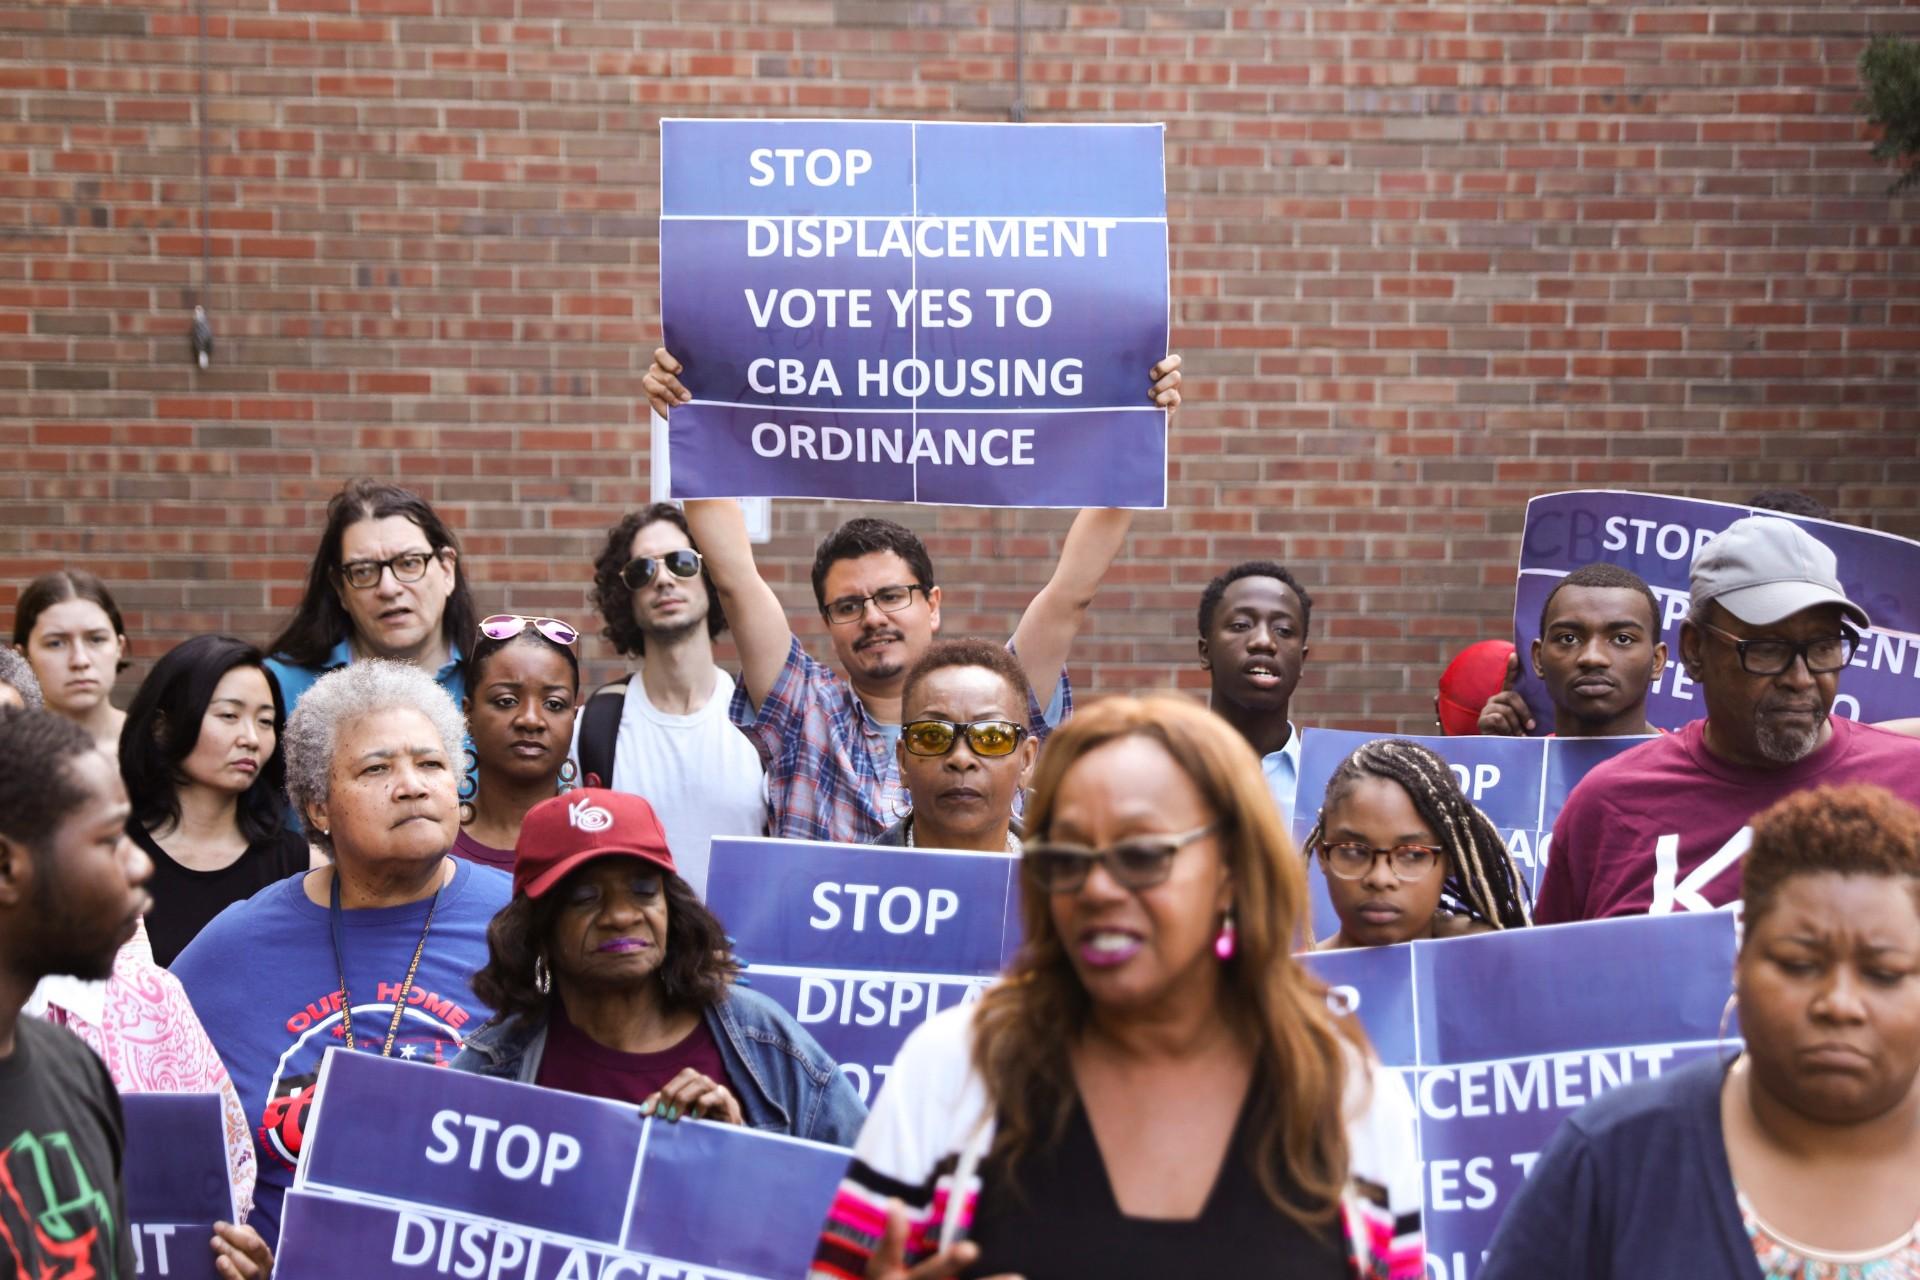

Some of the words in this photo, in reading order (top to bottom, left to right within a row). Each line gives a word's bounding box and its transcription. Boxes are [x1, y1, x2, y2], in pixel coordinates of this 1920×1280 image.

[748, 148, 873, 187] STOP
[746, 219, 1117, 258] DISPLACEMENT
[745, 289, 873, 328] VOTE
[886, 289, 973, 328] YES
[986, 289, 1053, 328] TO
[747, 358, 842, 397] CBA
[858, 358, 1084, 397] HOUSING
[751, 422, 1036, 466] ORDINANCE
[810, 882, 958, 935] STOP
[401, 974, 414, 995] HIGH
[377, 983, 470, 1030] HOME
[426, 1109, 581, 1186] STOP
[1418, 1156, 1498, 1211] ES
